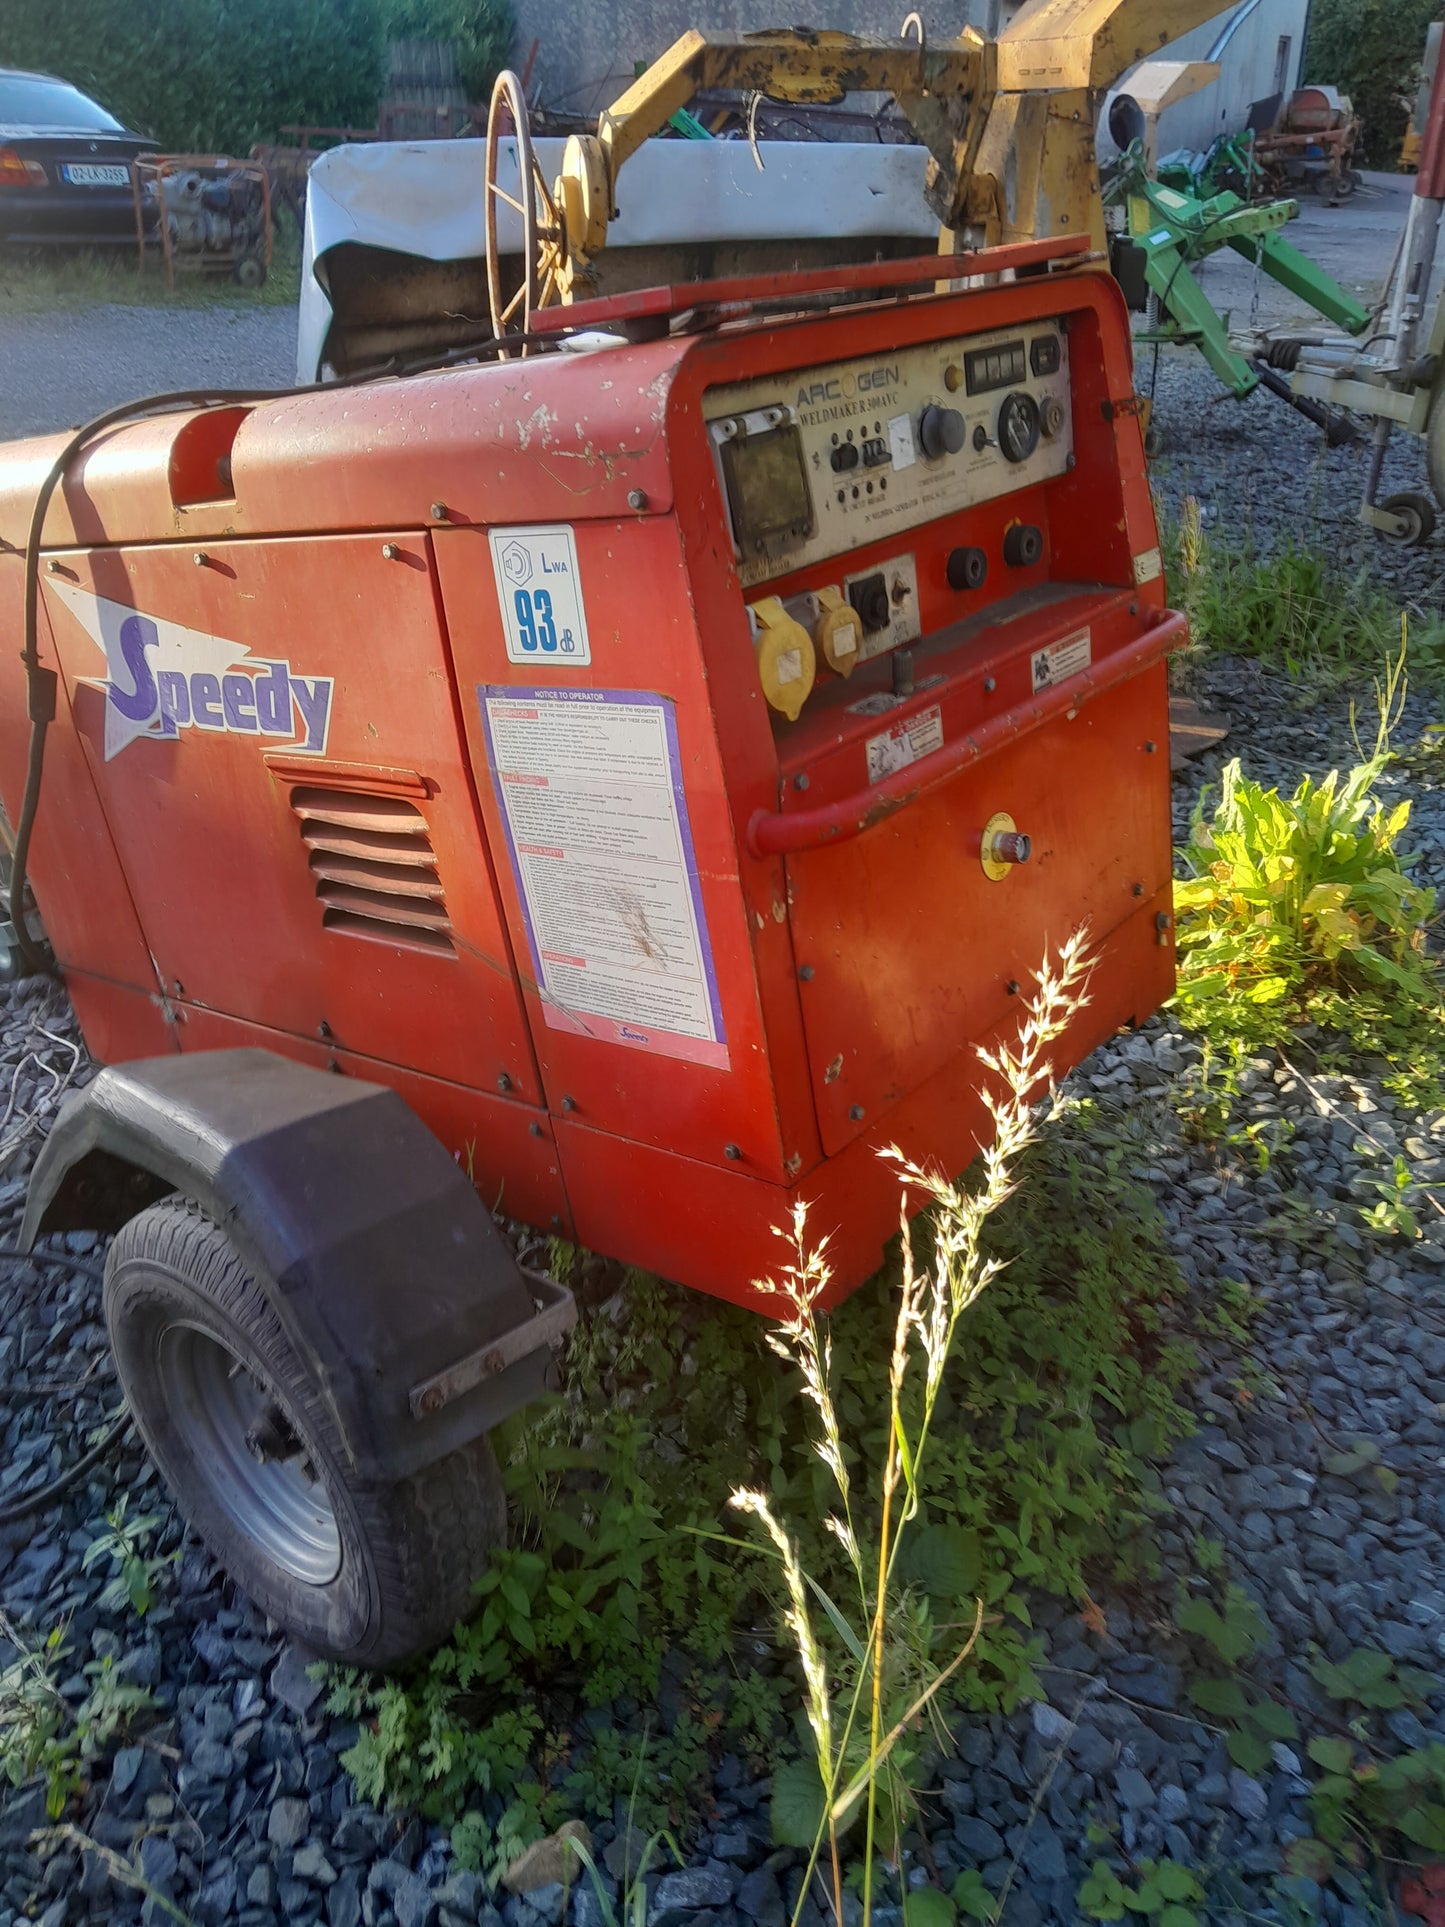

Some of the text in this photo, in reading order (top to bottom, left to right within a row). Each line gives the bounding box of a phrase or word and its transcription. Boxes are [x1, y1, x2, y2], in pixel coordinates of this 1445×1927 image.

[799, 400, 866, 427] WELDMAKER
[514, 589, 557, 652] 93
[108, 615, 334, 752] Speedy
[534, 691, 605, 701] NOTICE TO OPERATOR
[497, 700, 517, 708] following
[596, 705, 618, 713] operation
[634, 707, 660, 715] equipment
